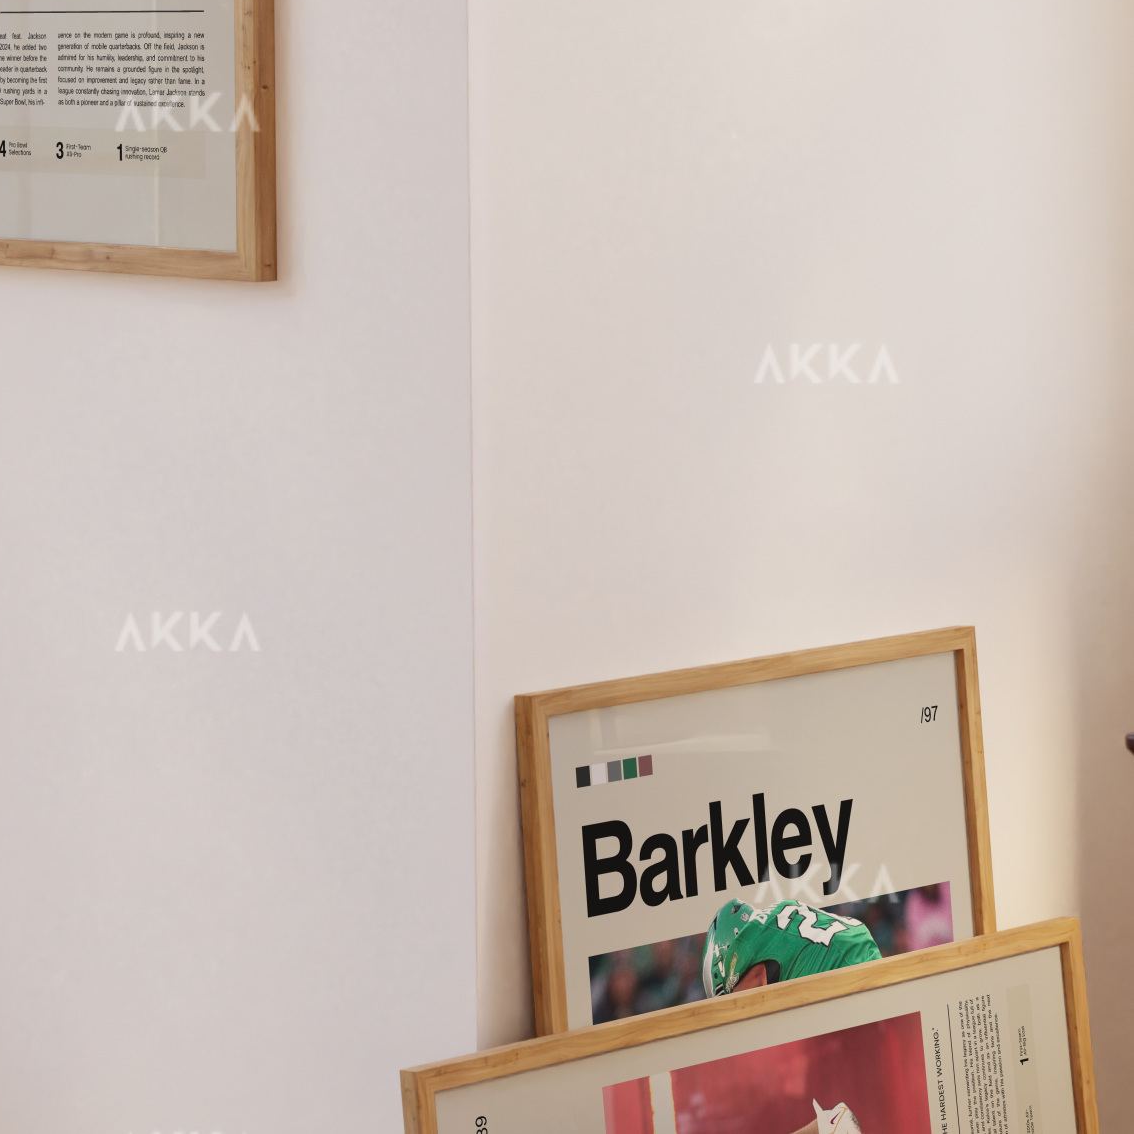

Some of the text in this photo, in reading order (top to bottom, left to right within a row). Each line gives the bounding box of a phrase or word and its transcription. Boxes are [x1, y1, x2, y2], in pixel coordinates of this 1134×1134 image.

[0, 140, 6, 157] 4
[56, 142, 64, 159] 3
[117, 144, 122, 161] 1
[921, 705, 938, 724] /97
[582, 793, 853, 918] Barkley
[938, 1080, 947, 1121] HARDEST
